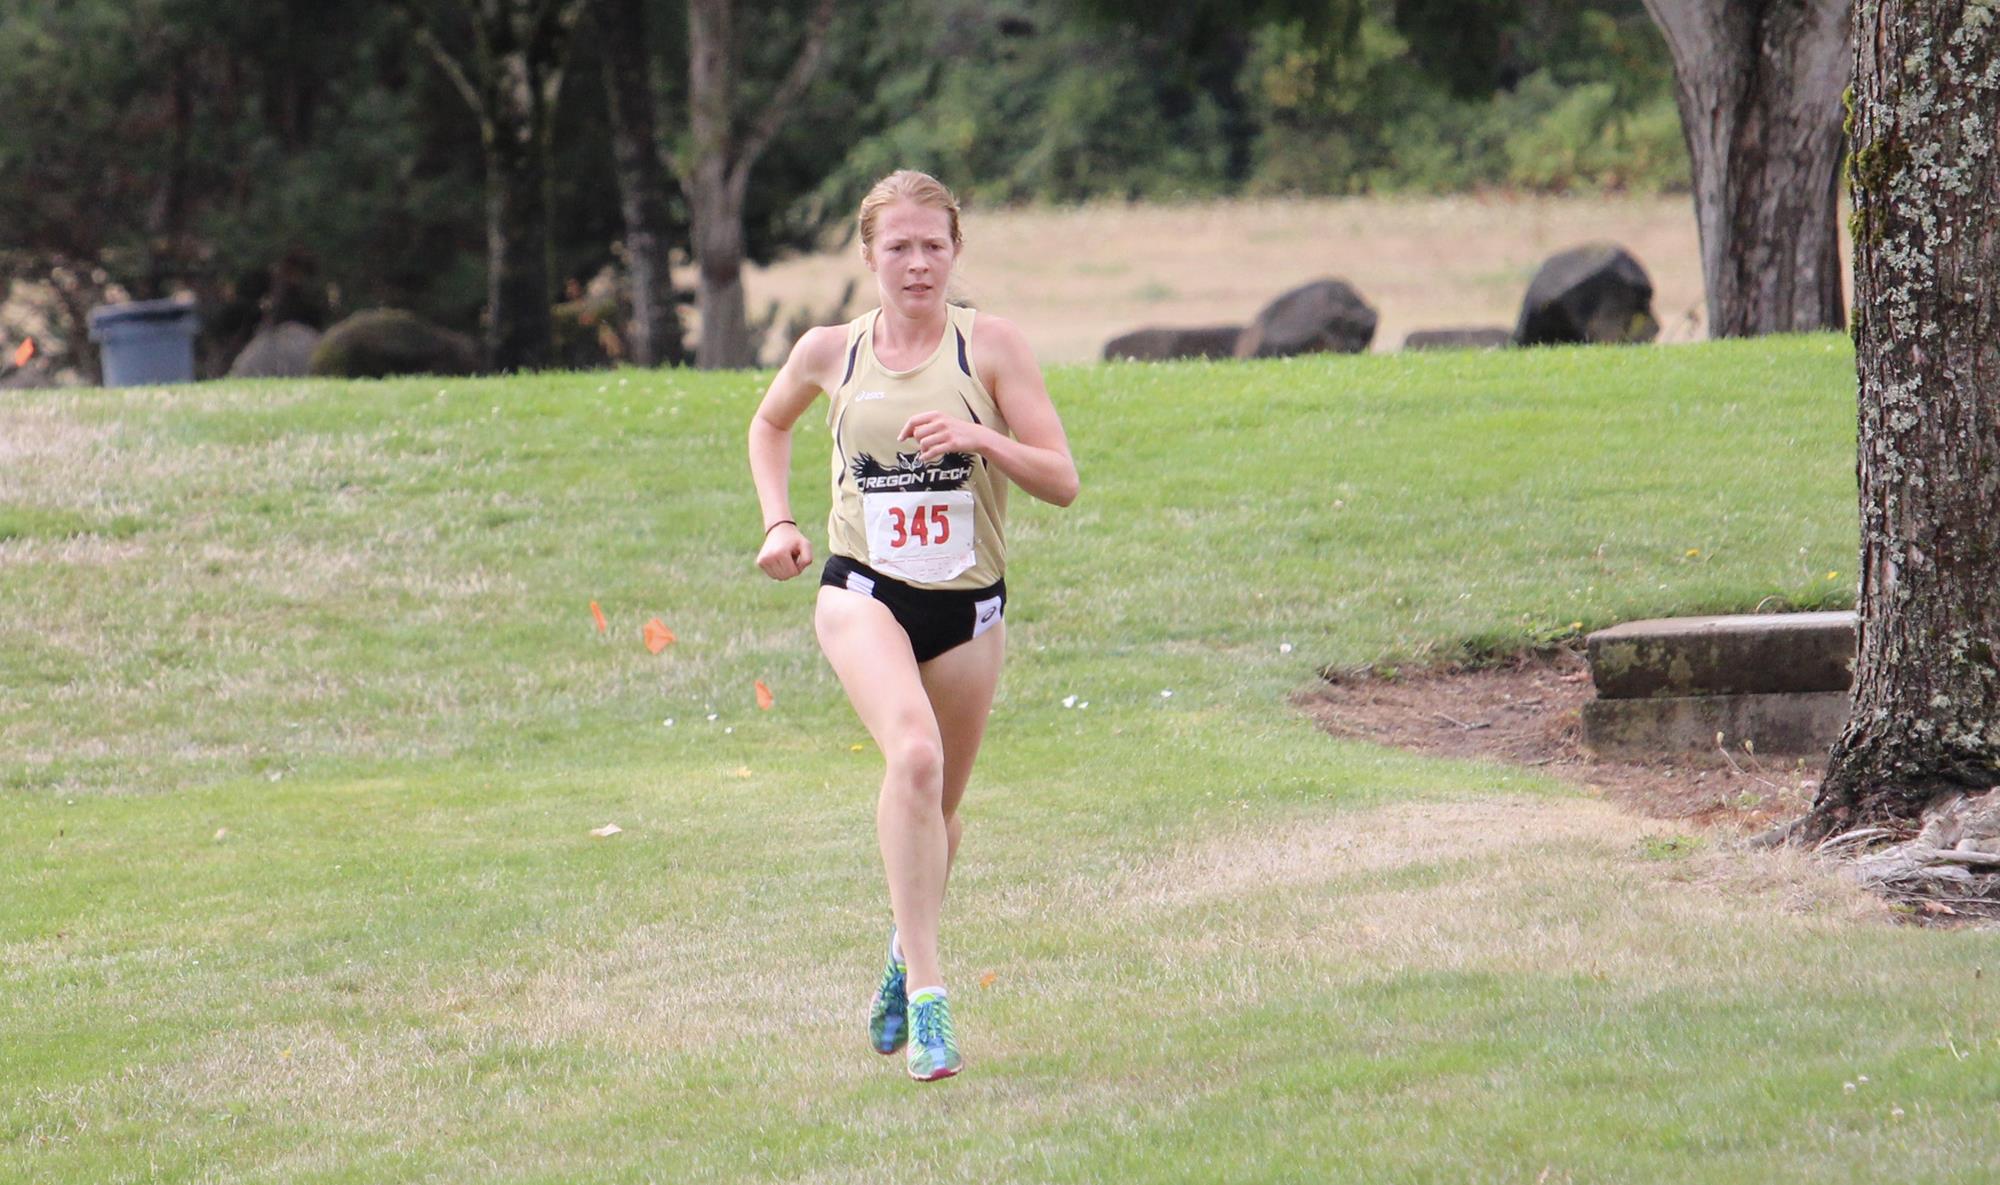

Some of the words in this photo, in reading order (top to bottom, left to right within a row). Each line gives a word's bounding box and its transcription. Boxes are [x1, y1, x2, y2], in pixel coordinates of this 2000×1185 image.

[855, 473, 925, 491] OREGON
[926, 466, 972, 482] TECH
[888, 504, 950, 548] 345
